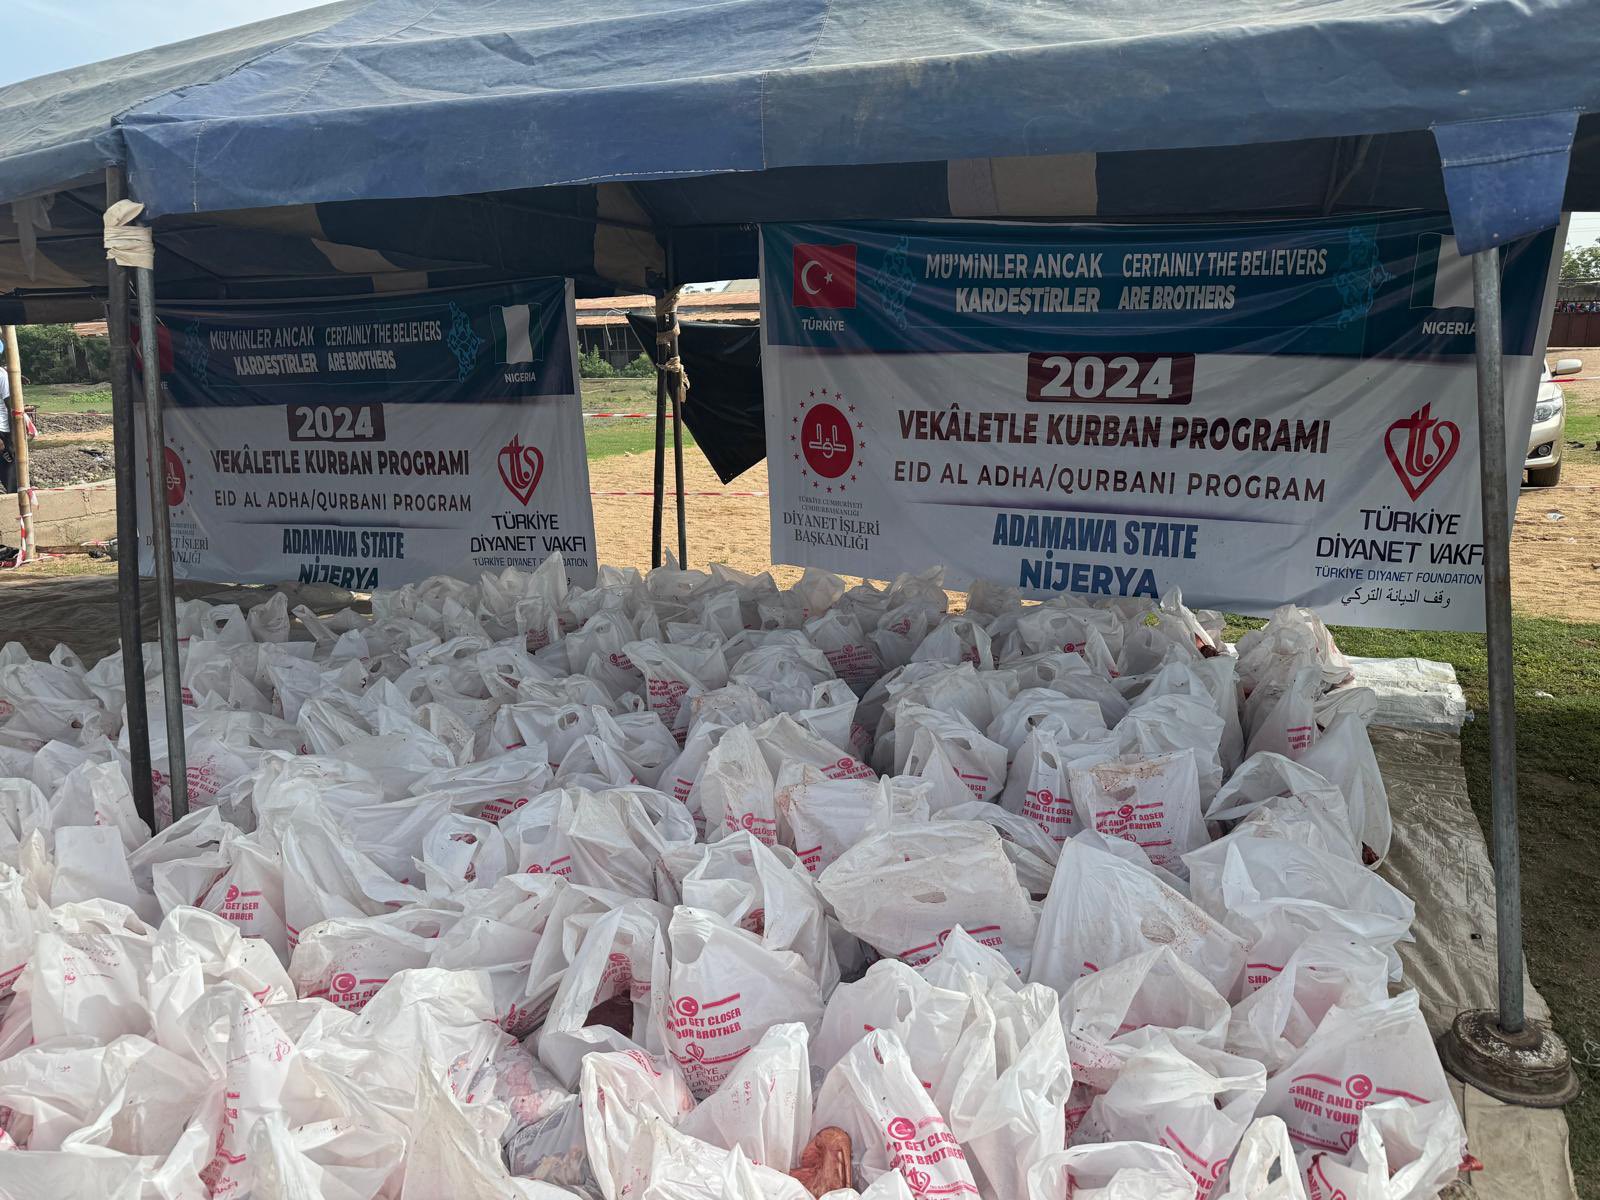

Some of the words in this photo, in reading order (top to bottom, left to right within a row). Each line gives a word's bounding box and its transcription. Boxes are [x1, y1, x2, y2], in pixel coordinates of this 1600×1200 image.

[1032, 253, 1103, 279] ANCAK
[1122, 250, 1206, 278] CERTAINLY
[1207, 252, 1237, 277] THE
[1239, 248, 1328, 276] BELIEVERS
[955, 286, 1100, 316] KARDEŞTİRLER
[1118, 285, 1150, 310] ARE
[1152, 284, 1236, 310] BROTHERS
[325, 324, 370, 347] CERTAINLY
[370, 323, 391, 344] THE
[392, 320, 442, 343] BELIEVERS
[801, 315, 845, 332] TÜRKİYE
[1422, 321, 1477, 335] NIGERIA
[274, 326, 315, 347] ANCAK
[234, 353, 320, 377] KARDEŞTİRLER
[327, 352, 347, 372] ARE
[347, 350, 397, 371] BROTHERS
[504, 371, 537, 384] NIGERIA
[1040, 356, 1174, 399] 2024
[296, 405, 374, 439] 2024
[898, 402, 1039, 444] VEKÂLETLE
[1046, 413, 1161, 450] KURBAN
[1170, 416, 1331, 454] PROGRAMI
[211, 443, 300, 475] VEKÂLETLE
[305, 449, 373, 476] KURBAN
[378, 450, 469, 476] PROGRAMI
[894, 460, 931, 483] EID
[939, 463, 968, 486] AL
[977, 463, 1176, 495] ADHA/QURBANI
[1187, 472, 1326, 502] PROGRAM
[215, 489, 239, 507] EID
[243, 489, 262, 508] AL
[267, 488, 387, 511] ADHA/QURBANI
[393, 492, 472, 512] PROGRAM
[491, 510, 560, 531] TÜRKİYE
[783, 511, 837, 531] DİYANET
[839, 516, 880, 536] İŞLERİ
[1359, 505, 1461, 535] TÜRKİYE
[282, 528, 358, 559] ADAMAWA
[360, 530, 404, 560] STATE
[470, 533, 538, 553] DİYANET
[544, 534, 588, 553] VAKFI
[795, 528, 869, 551] BAŞKANLIĞI
[992, 513, 1118, 554] ADAMAWA
[1123, 520, 1199, 560] STATE
[1316, 532, 1423, 564] DİYANET
[298, 556, 379, 590] NİJERYA
[472, 555, 504, 568] TÜRKİYE
[1019, 550, 1160, 599] NİJERYA
[1315, 565, 1364, 580] TÜRKİYE
[1367, 569, 1413, 582] DIYANET
[1416, 571, 1483, 585] FOUNDATION
[1340, 587, 1382, 606] التركي
[1385, 589, 1420, 606] الديانة
[1424, 590, 1451, 608] وقف
[225, 902, 240, 910] GET
[342, 992, 360, 1002] GET
[689, 1017, 705, 1028] GET
[707, 1009, 743, 1026] CLOSER
[695, 1022, 743, 1040] BROTHER
[1288, 1085, 1325, 1103] SHARE
[1326, 1094, 1353, 1109] AND
[1293, 1096, 1322, 1117] WITH
[1325, 1106, 1360, 1126] YOUR
[905, 1139, 926, 1152] GET
[916, 1147, 966, 1166] BROTHER
